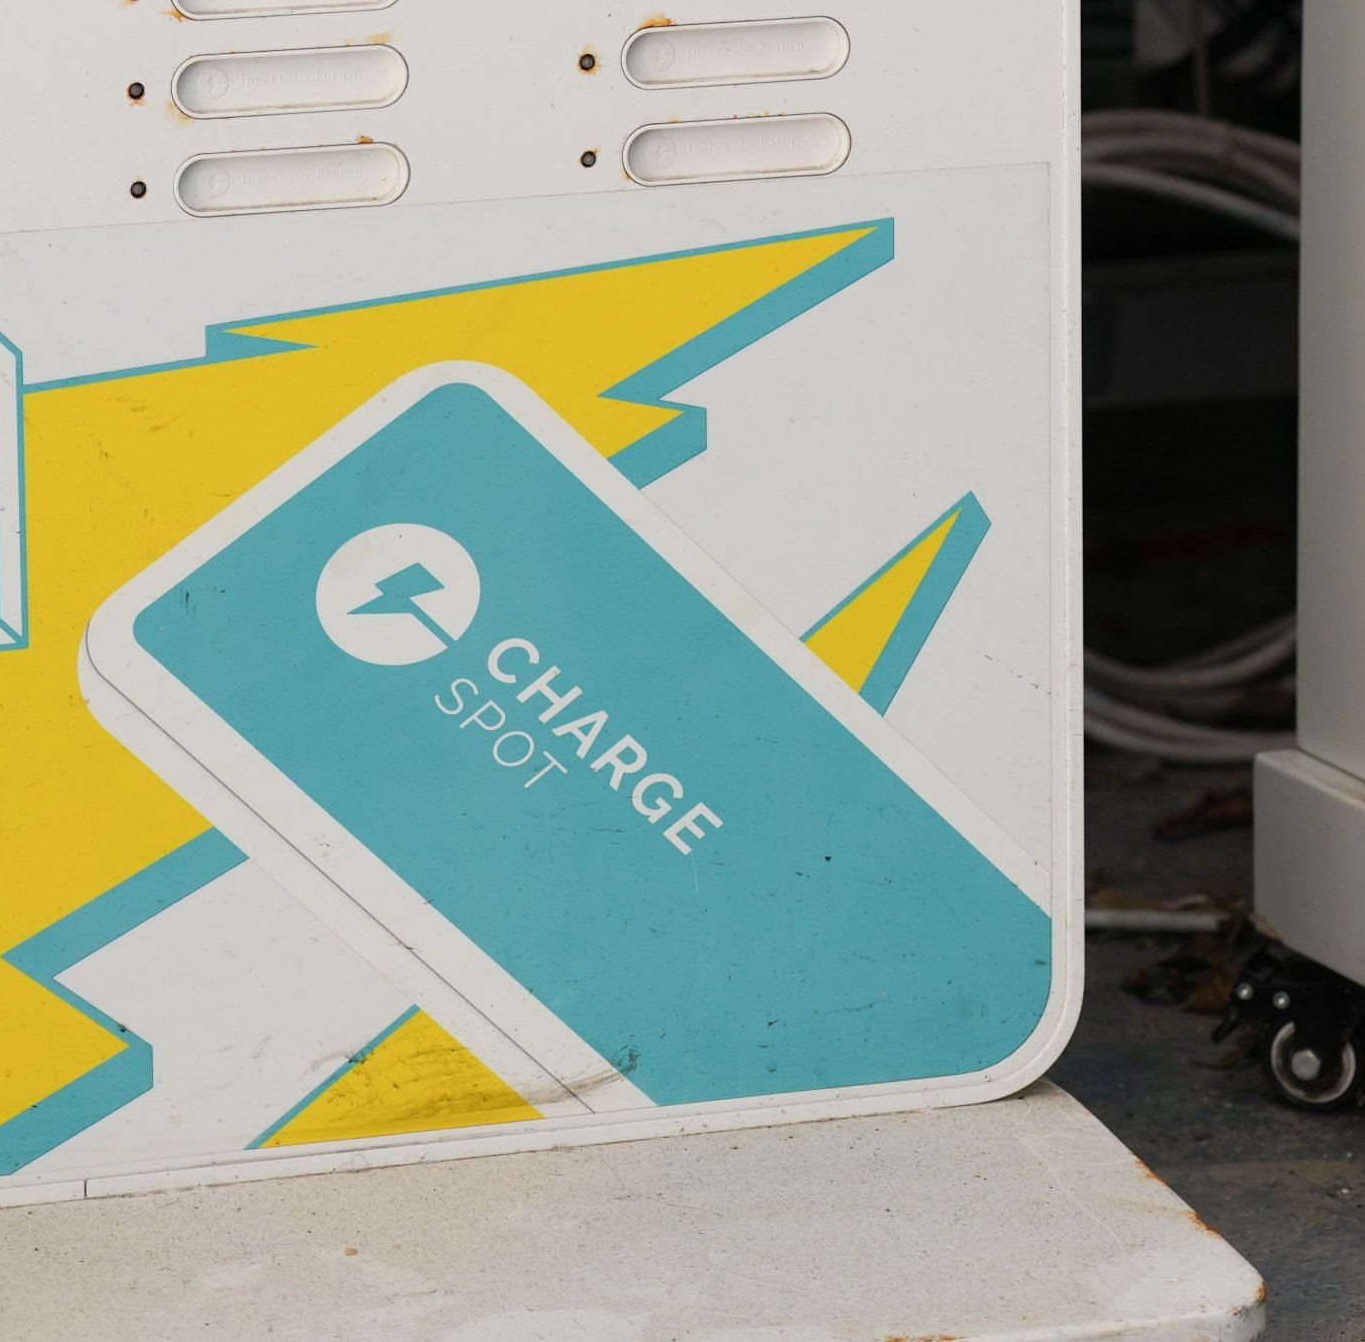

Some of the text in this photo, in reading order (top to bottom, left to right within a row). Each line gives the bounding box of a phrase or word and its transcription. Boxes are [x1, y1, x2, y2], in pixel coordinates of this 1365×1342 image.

[759, 41, 804, 52] Return
[315, 69, 361, 82] Return
[759, 138, 804, 148] Return
[316, 168, 361, 178] Return
[434, 677, 568, 789] SPOT
[487, 637, 724, 856] CHARGE
